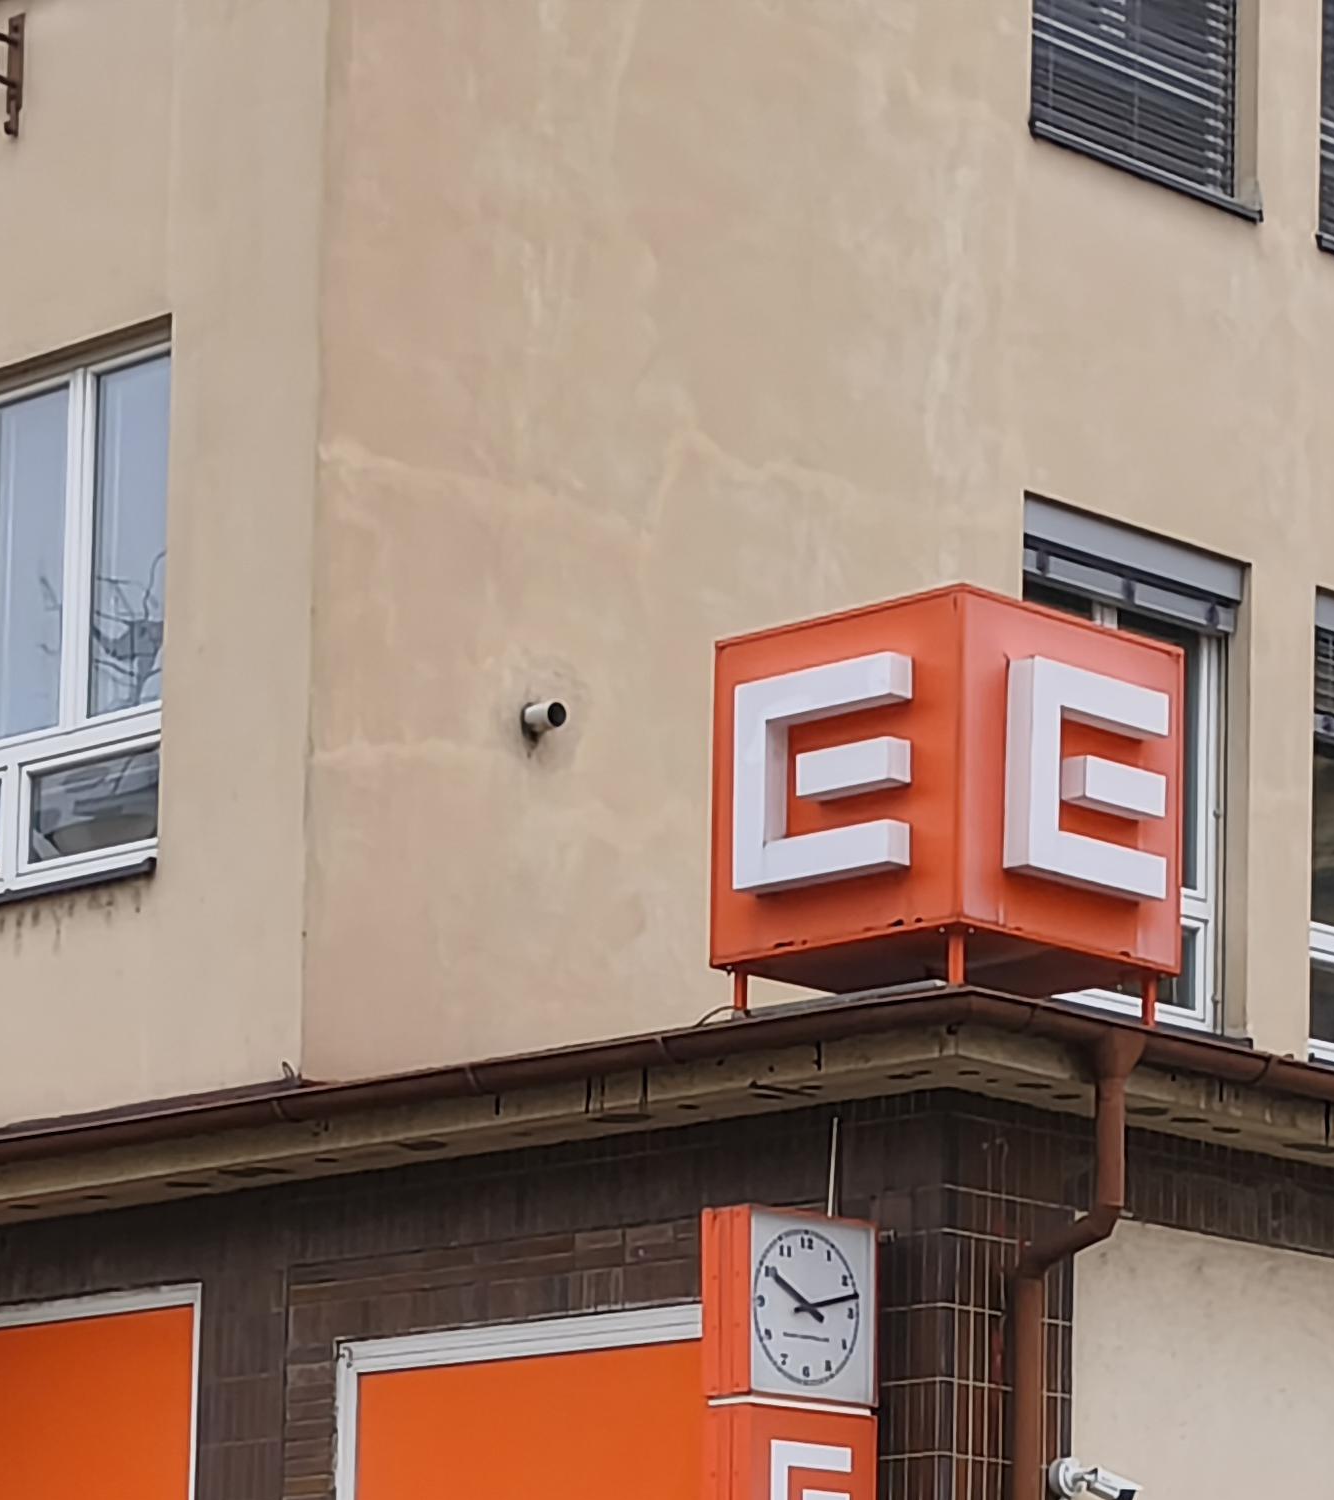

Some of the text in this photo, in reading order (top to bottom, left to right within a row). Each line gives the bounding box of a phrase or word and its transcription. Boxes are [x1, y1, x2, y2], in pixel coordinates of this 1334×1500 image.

[801, 1236, 814, 1251] 12
[779, 1244, 792, 1258] 11
[841, 1274, 849, 1287] 2
[780, 1352, 788, 1366] 7
[802, 1365, 810, 1378] 6
